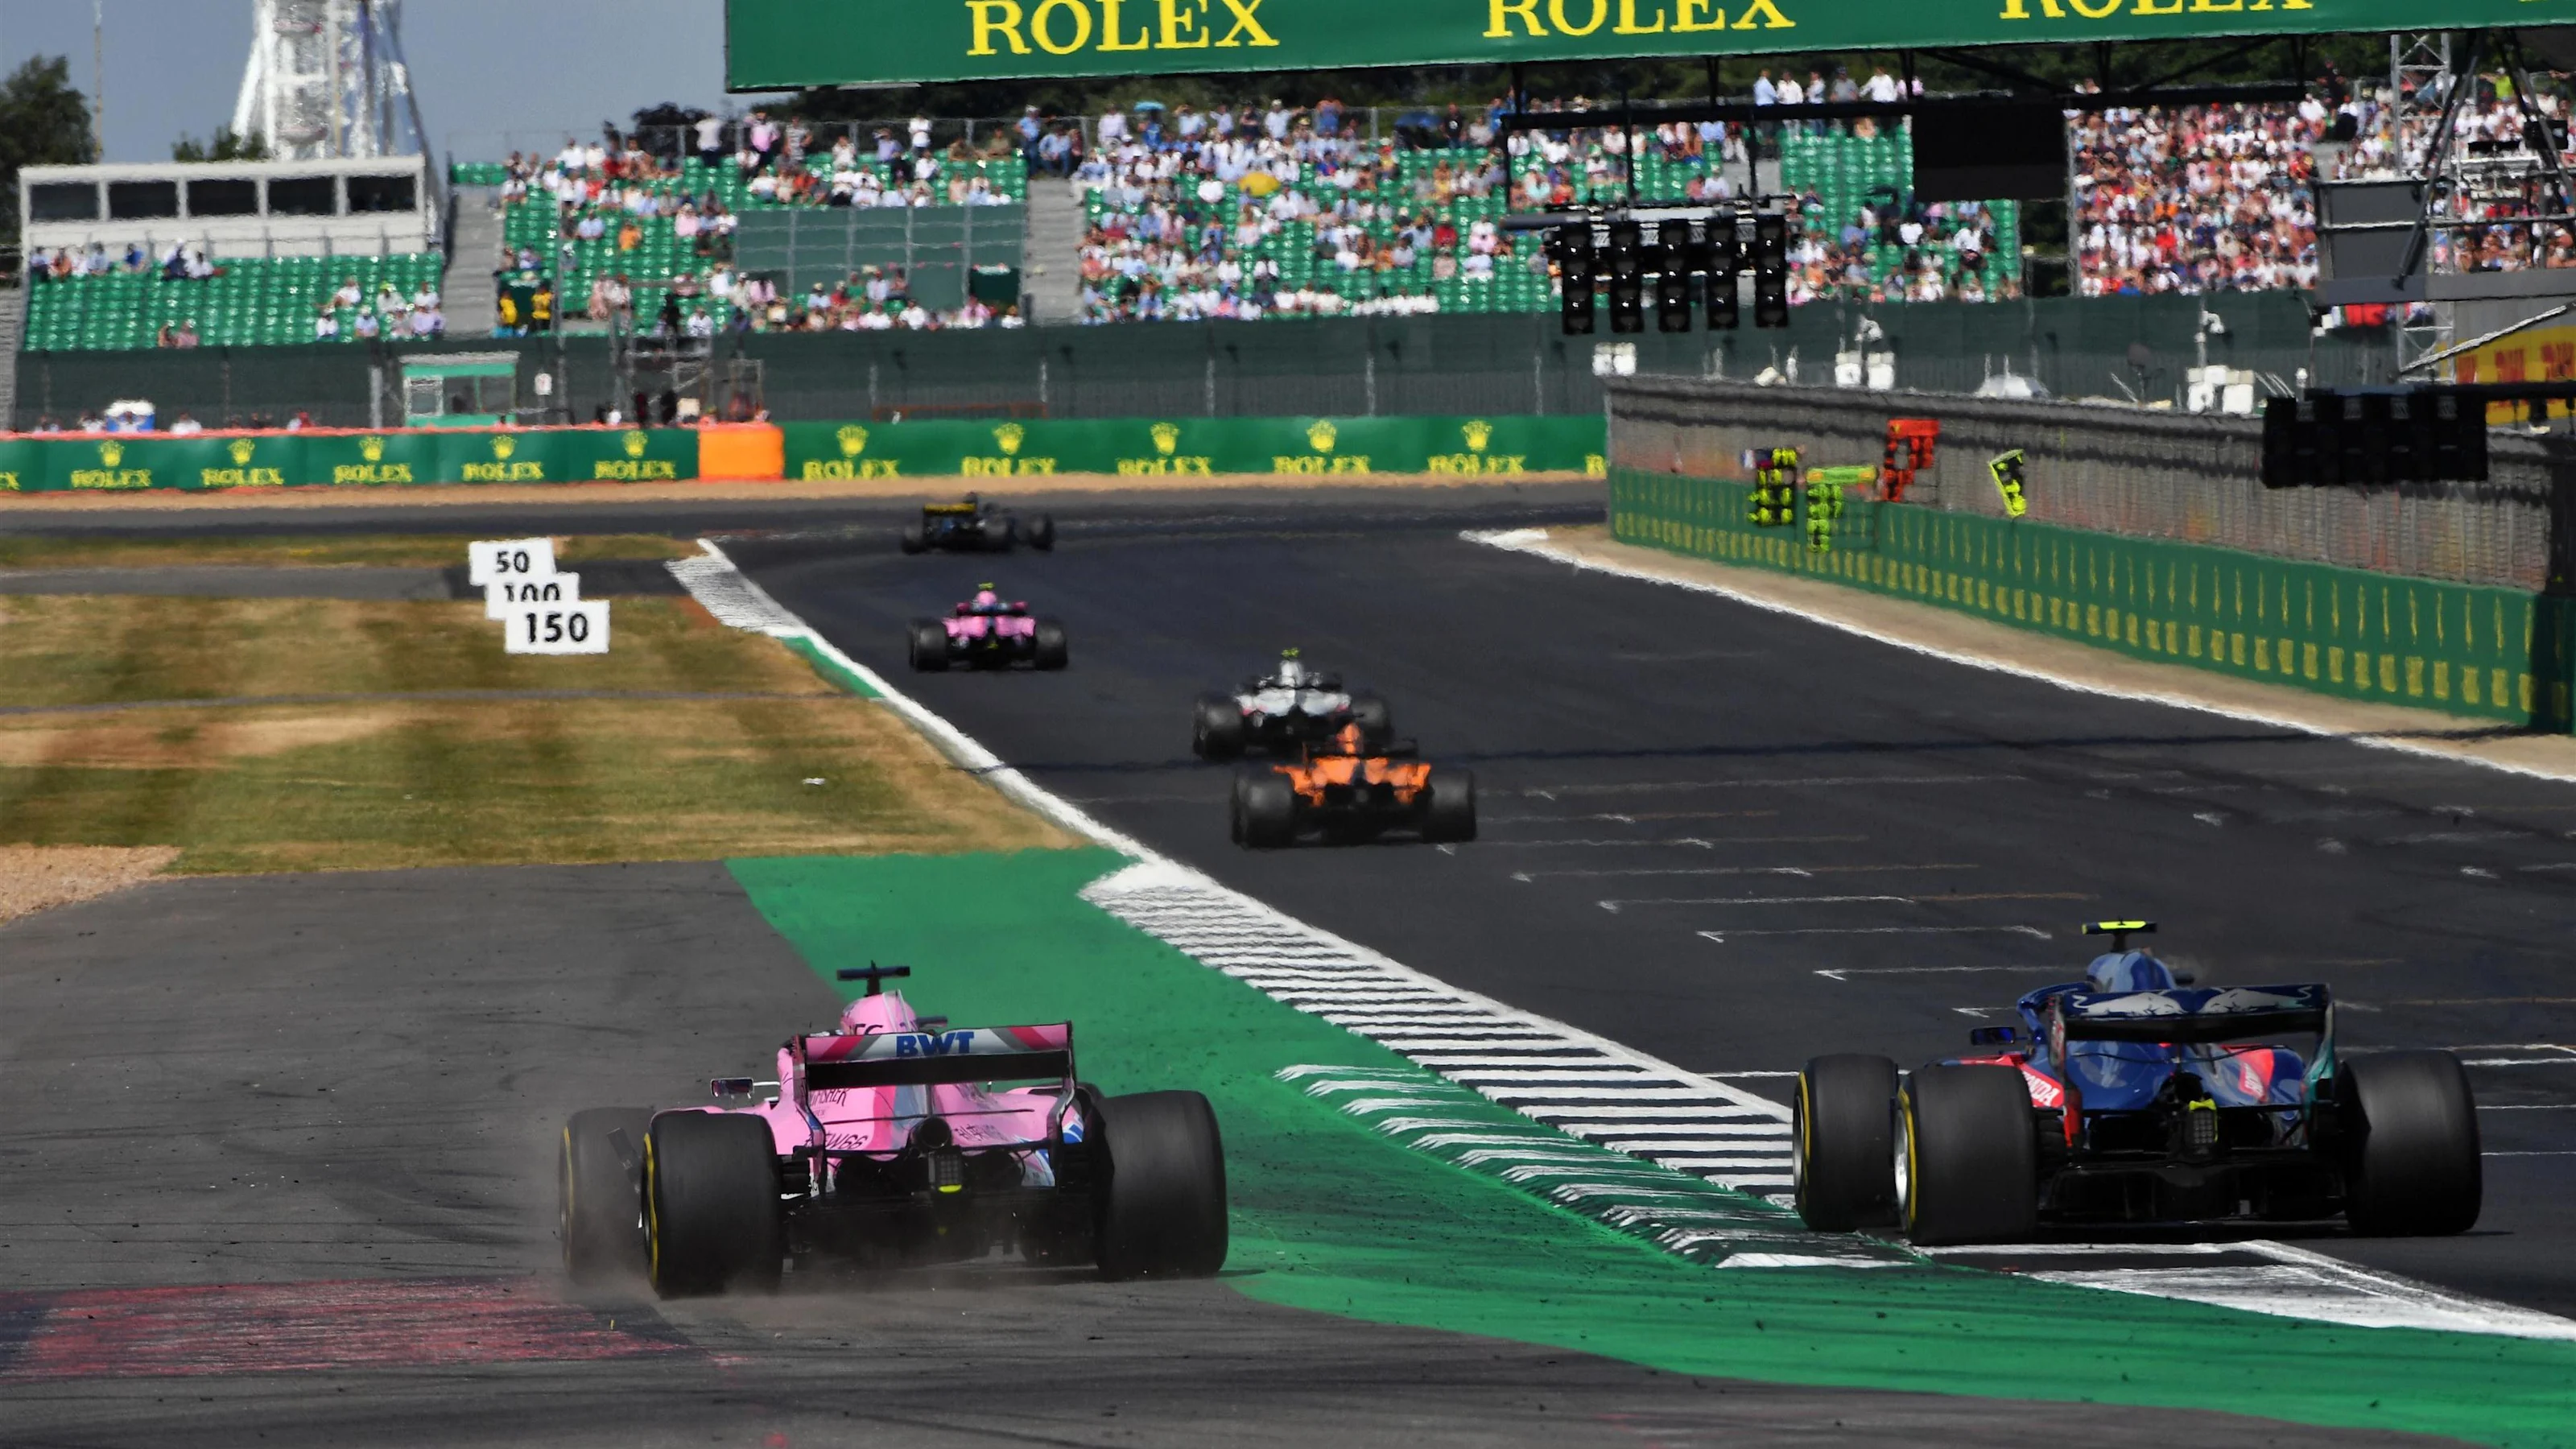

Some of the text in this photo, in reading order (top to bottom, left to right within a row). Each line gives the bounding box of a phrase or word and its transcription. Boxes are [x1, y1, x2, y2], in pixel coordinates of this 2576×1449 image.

[966, 0, 1280, 56] ROLEX
[1483, 0, 1796, 37] ROLEX
[333, 463, 414, 483] ROLEX
[461, 461, 543, 481] ROLEX
[594, 460, 675, 479] ROLEX
[803, 460, 900, 481] ROLEX
[962, 456, 1056, 478] ROLEX
[1117, 456, 1213, 477] ROLEX
[1272, 455, 1369, 475] ROLEX
[1427, 453, 1526, 476] ROLEX
[70, 469, 152, 488] ROLEX
[200, 468, 284, 486] ROLEX
[496, 551, 530, 573] 50
[505, 583, 560, 602] 100
[526, 613, 588, 642] 150
[896, 1031, 975, 1057] BWT
